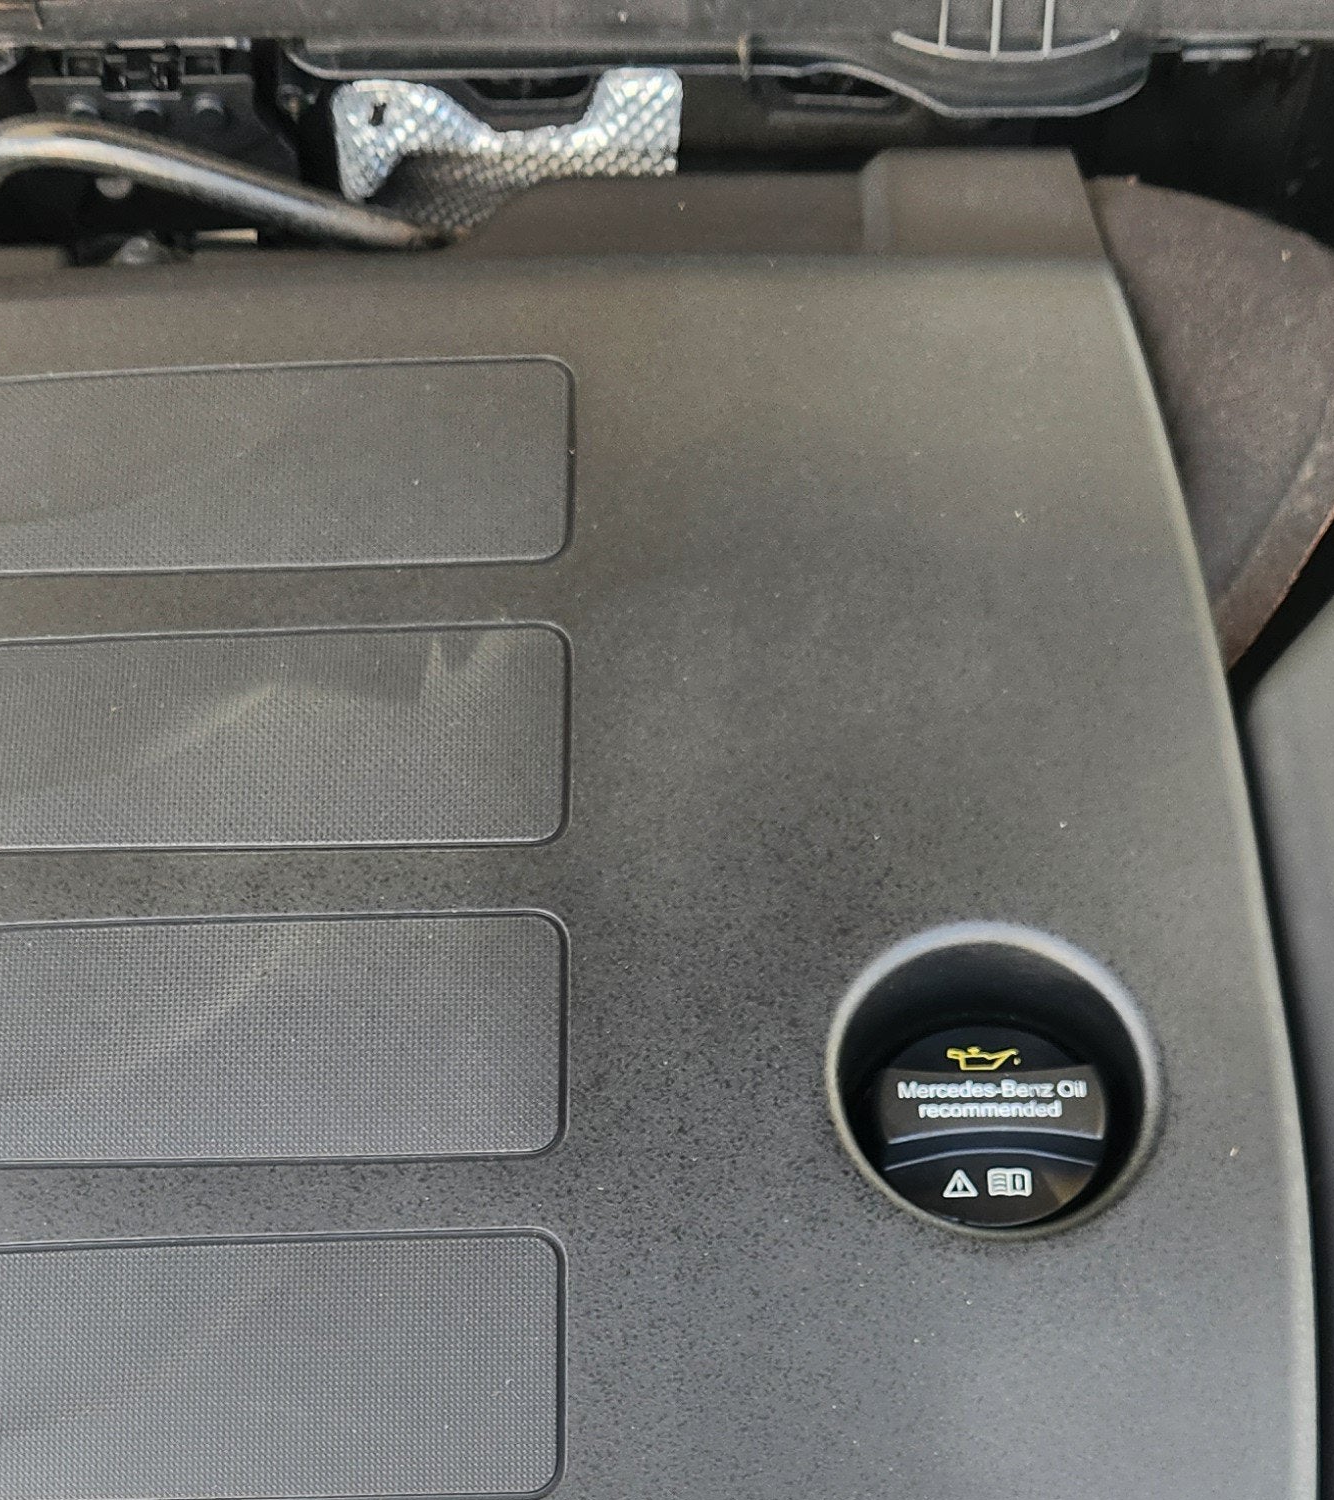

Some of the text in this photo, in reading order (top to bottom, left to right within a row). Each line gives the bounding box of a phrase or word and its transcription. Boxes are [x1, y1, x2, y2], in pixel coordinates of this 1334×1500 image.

[897, 1079, 1088, 1099] Mercedes-Benz Oil
[918, 1099, 1064, 1119] recommended
